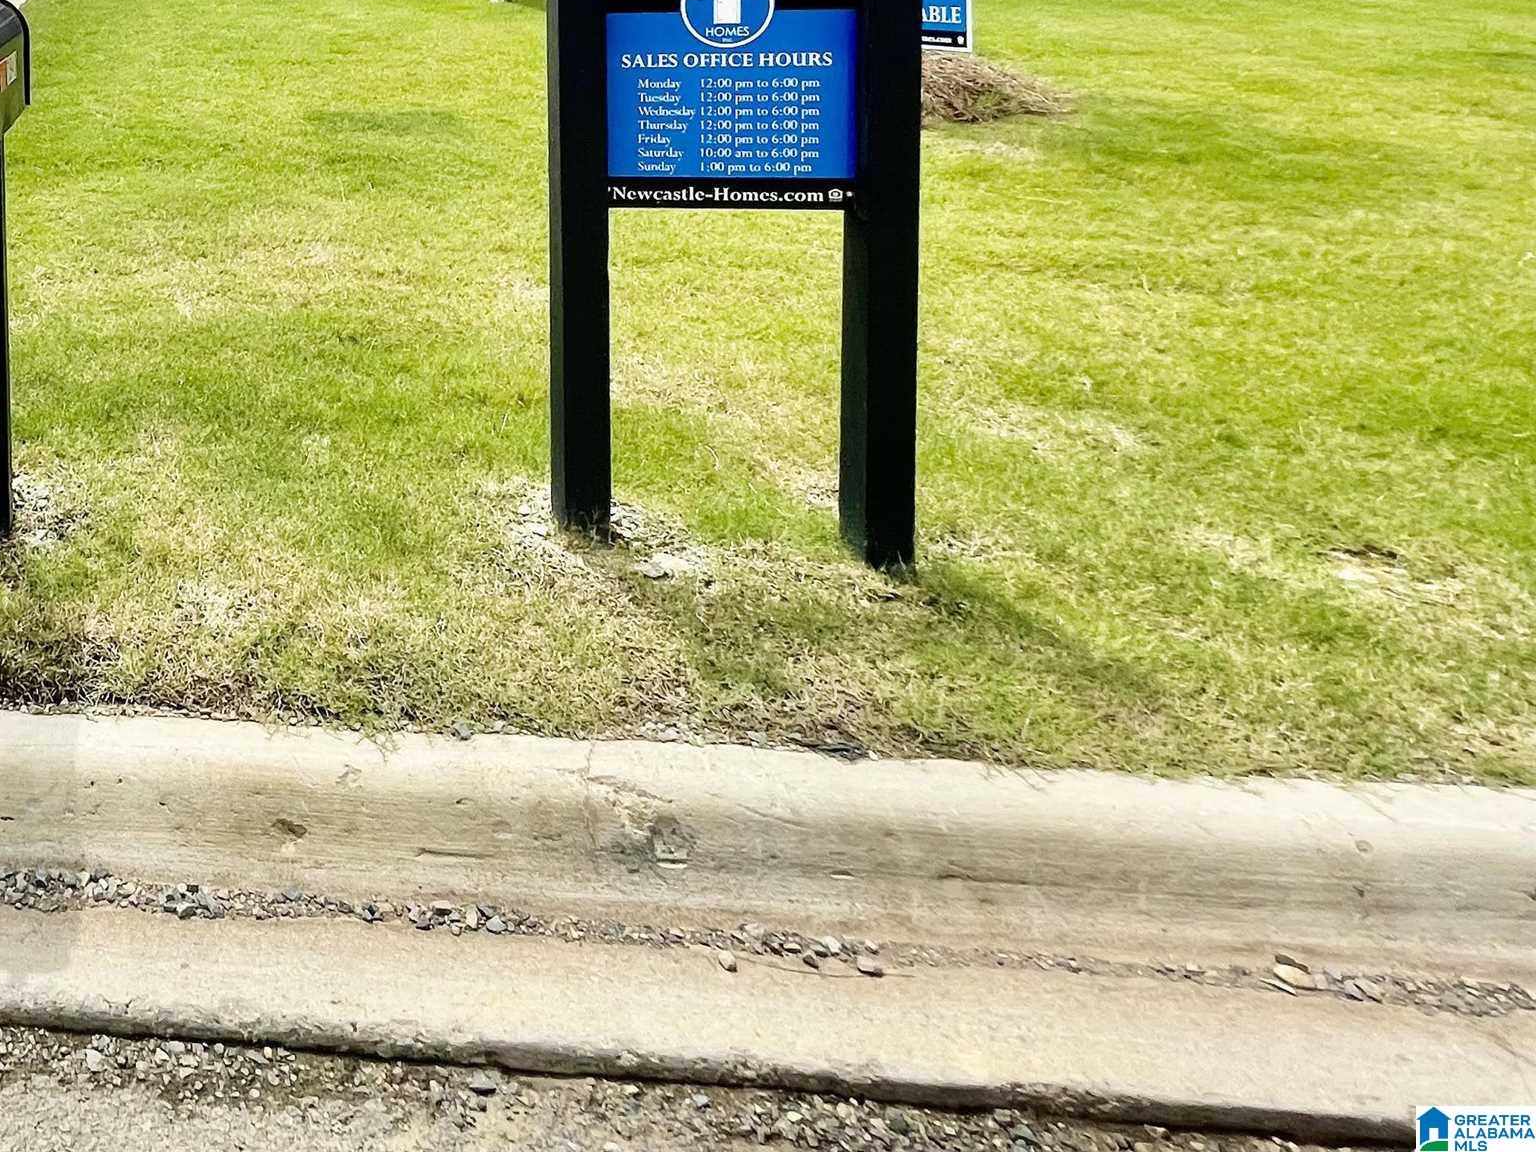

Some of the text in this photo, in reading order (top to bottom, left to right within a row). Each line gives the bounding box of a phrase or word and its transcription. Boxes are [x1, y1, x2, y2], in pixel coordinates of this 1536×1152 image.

[705, 26, 750, 37] HOMES
[621, 52, 833, 68] SALES OFFICE HOURS
[638, 77, 820, 91] Monday 12:00 pm to 6:00 pm
[638, 91, 820, 105] Tuesday 12:00 pm to 6:00 pm
[638, 105, 820, 119] Wednesday 12:00 pm to 6:00 pm
[638, 119, 820, 133] Thursday 12:00 pm to 6:00 pm
[638, 133, 820, 147] Friday 12:00 pm to 6:00 pm
[638, 148, 684, 161] Saturday
[700, 148, 732, 158] 10:00
[757, 149, 768, 158] to
[771, 147, 798, 158] 6:00
[801, 151, 820, 161] pm
[638, 161, 812, 175] Sunday 1:00 pm to 6:00 pm
[612, 186, 824, 202] Newcastle-Homes.com
